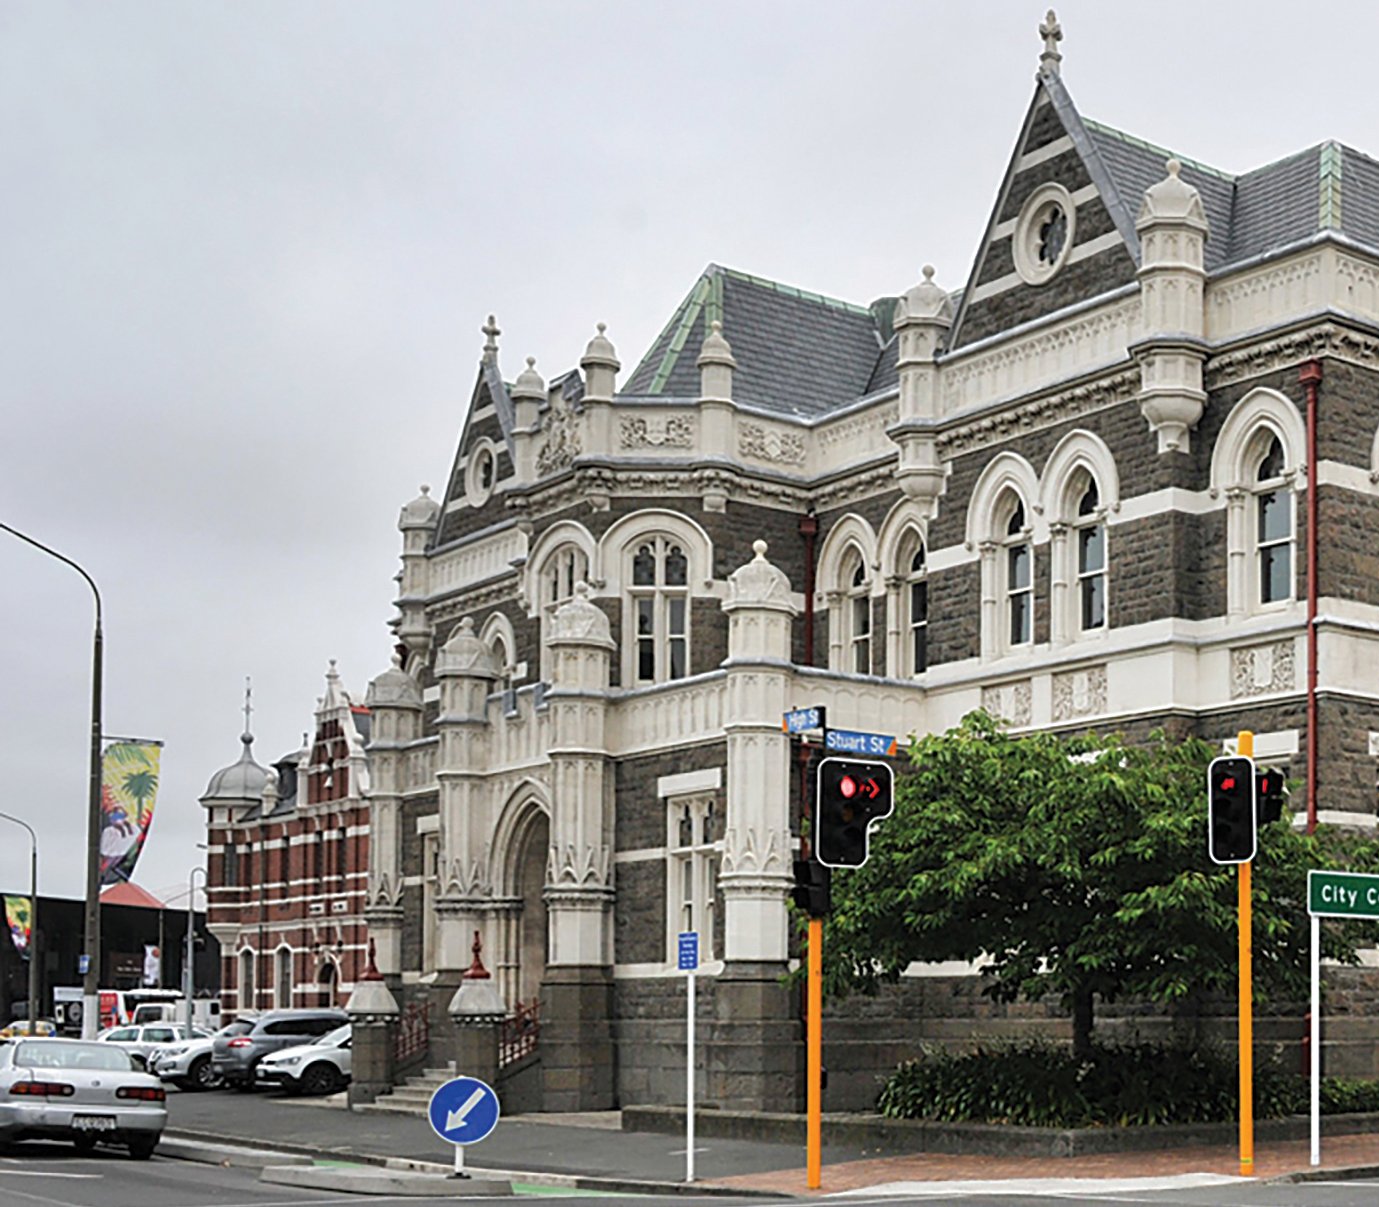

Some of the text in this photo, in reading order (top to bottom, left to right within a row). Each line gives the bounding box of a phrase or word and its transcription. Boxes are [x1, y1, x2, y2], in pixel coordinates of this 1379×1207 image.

[789, 708, 820, 731] High St
[827, 731, 885, 753] Stuart St
[1321, 884, 1358, 908] City
